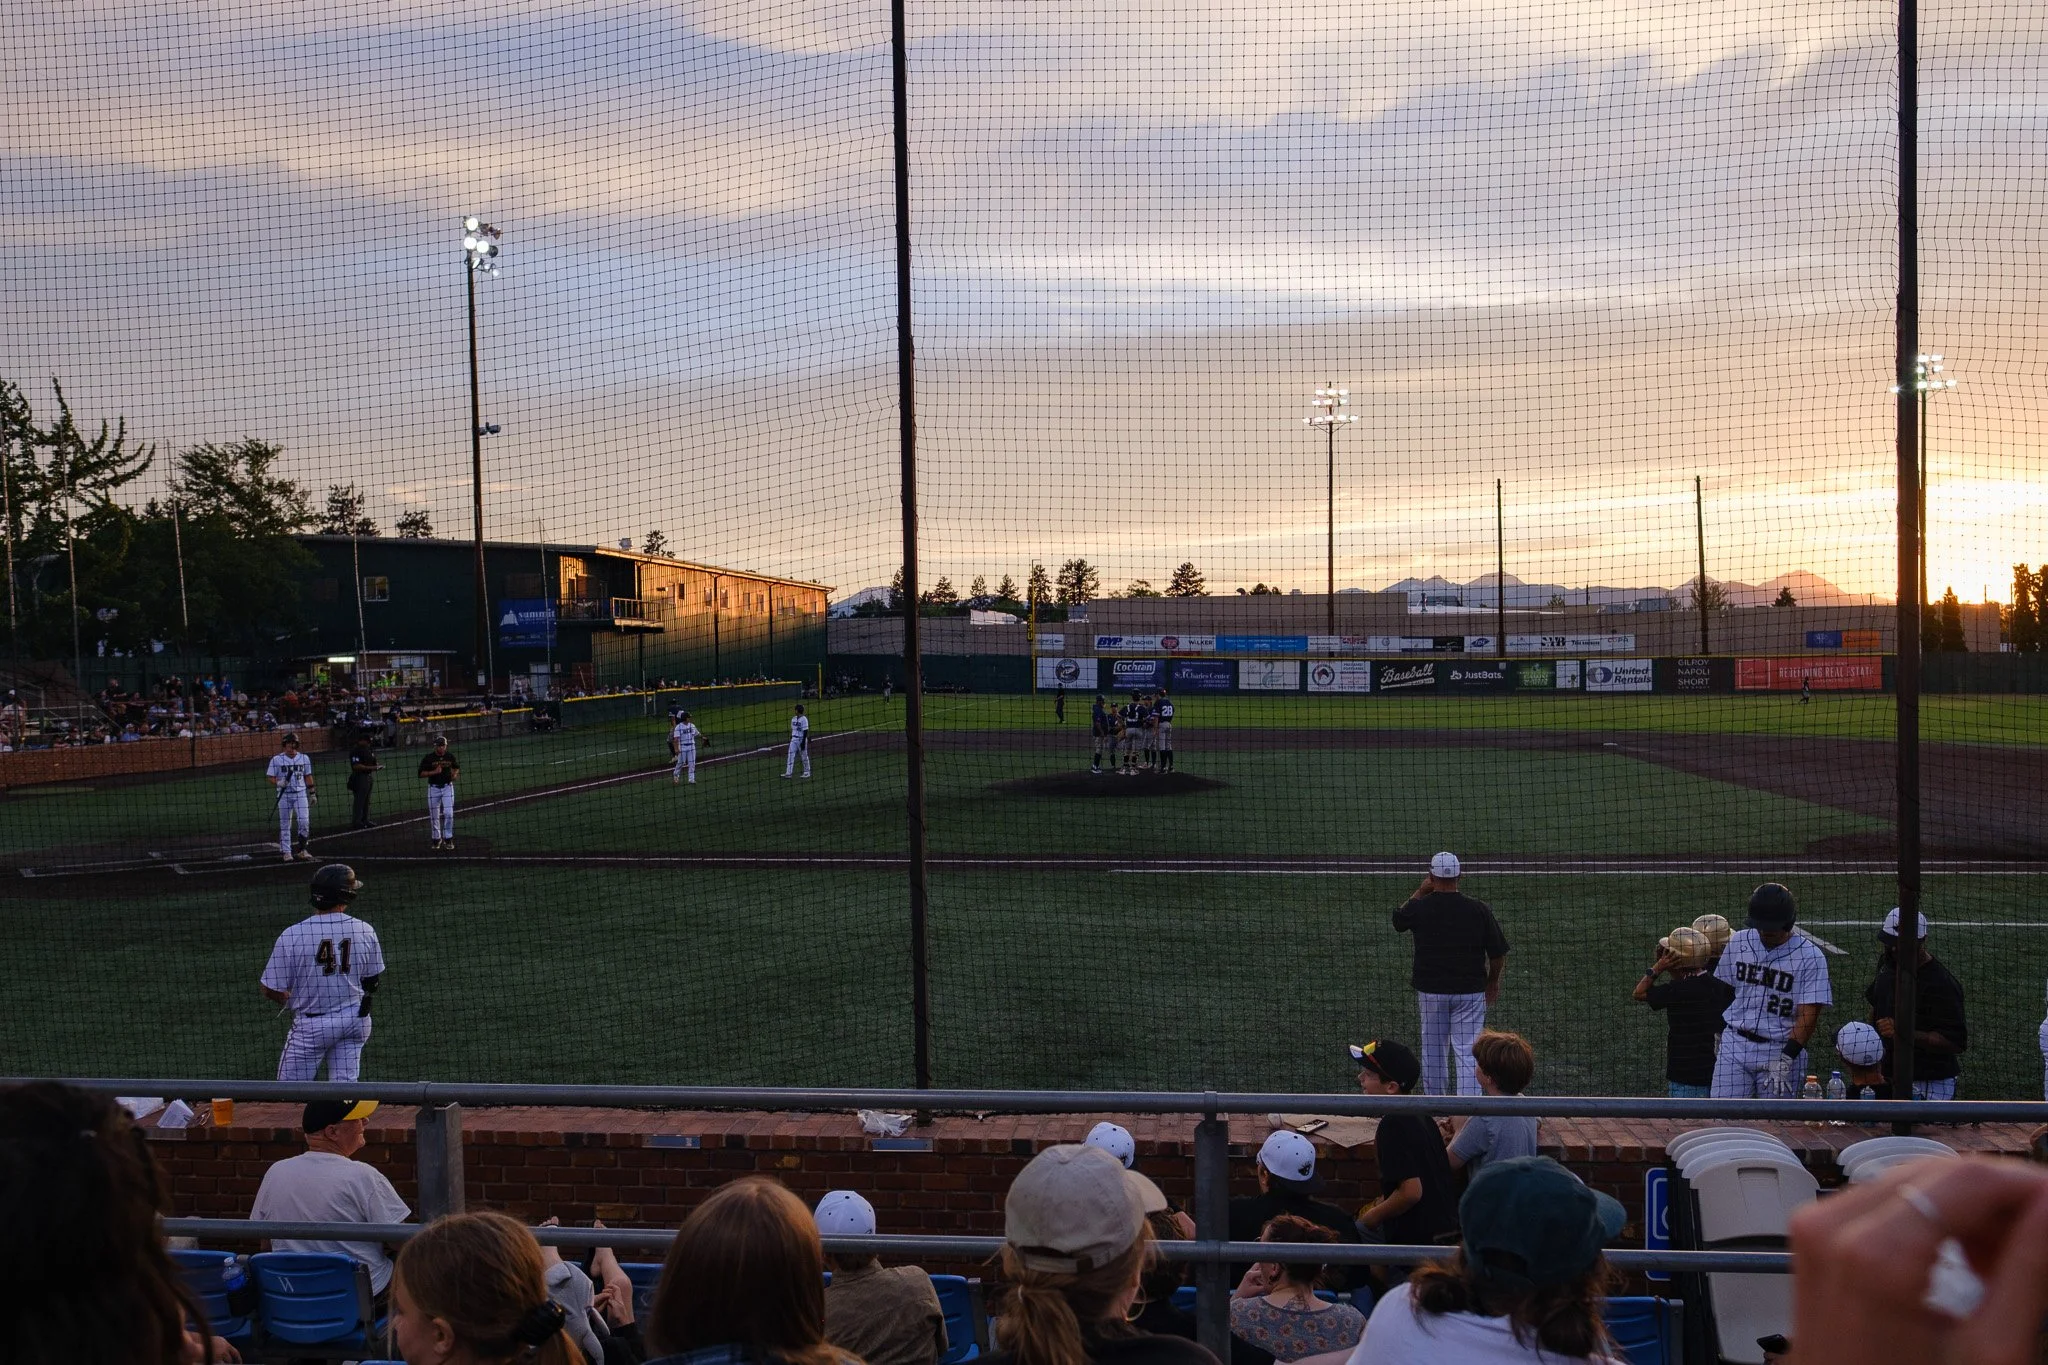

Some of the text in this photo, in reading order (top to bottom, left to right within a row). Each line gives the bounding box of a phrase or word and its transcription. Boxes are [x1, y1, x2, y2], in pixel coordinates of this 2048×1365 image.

[1116, 662, 1153, 672] Cochran
[1613, 666, 1649, 676] United
[1677, 668, 1711, 676] NAPOLI
[1380, 663, 1434, 684] Baseball
[1464, 671, 1505, 680] JustBats.
[1613, 675, 1653, 685] Rentals
[1677, 678, 1710, 686] SHORT
[314, 937, 352, 977] 41
[1735, 960, 1795, 994] BEND
[1767, 993, 1794, 1018] 22
